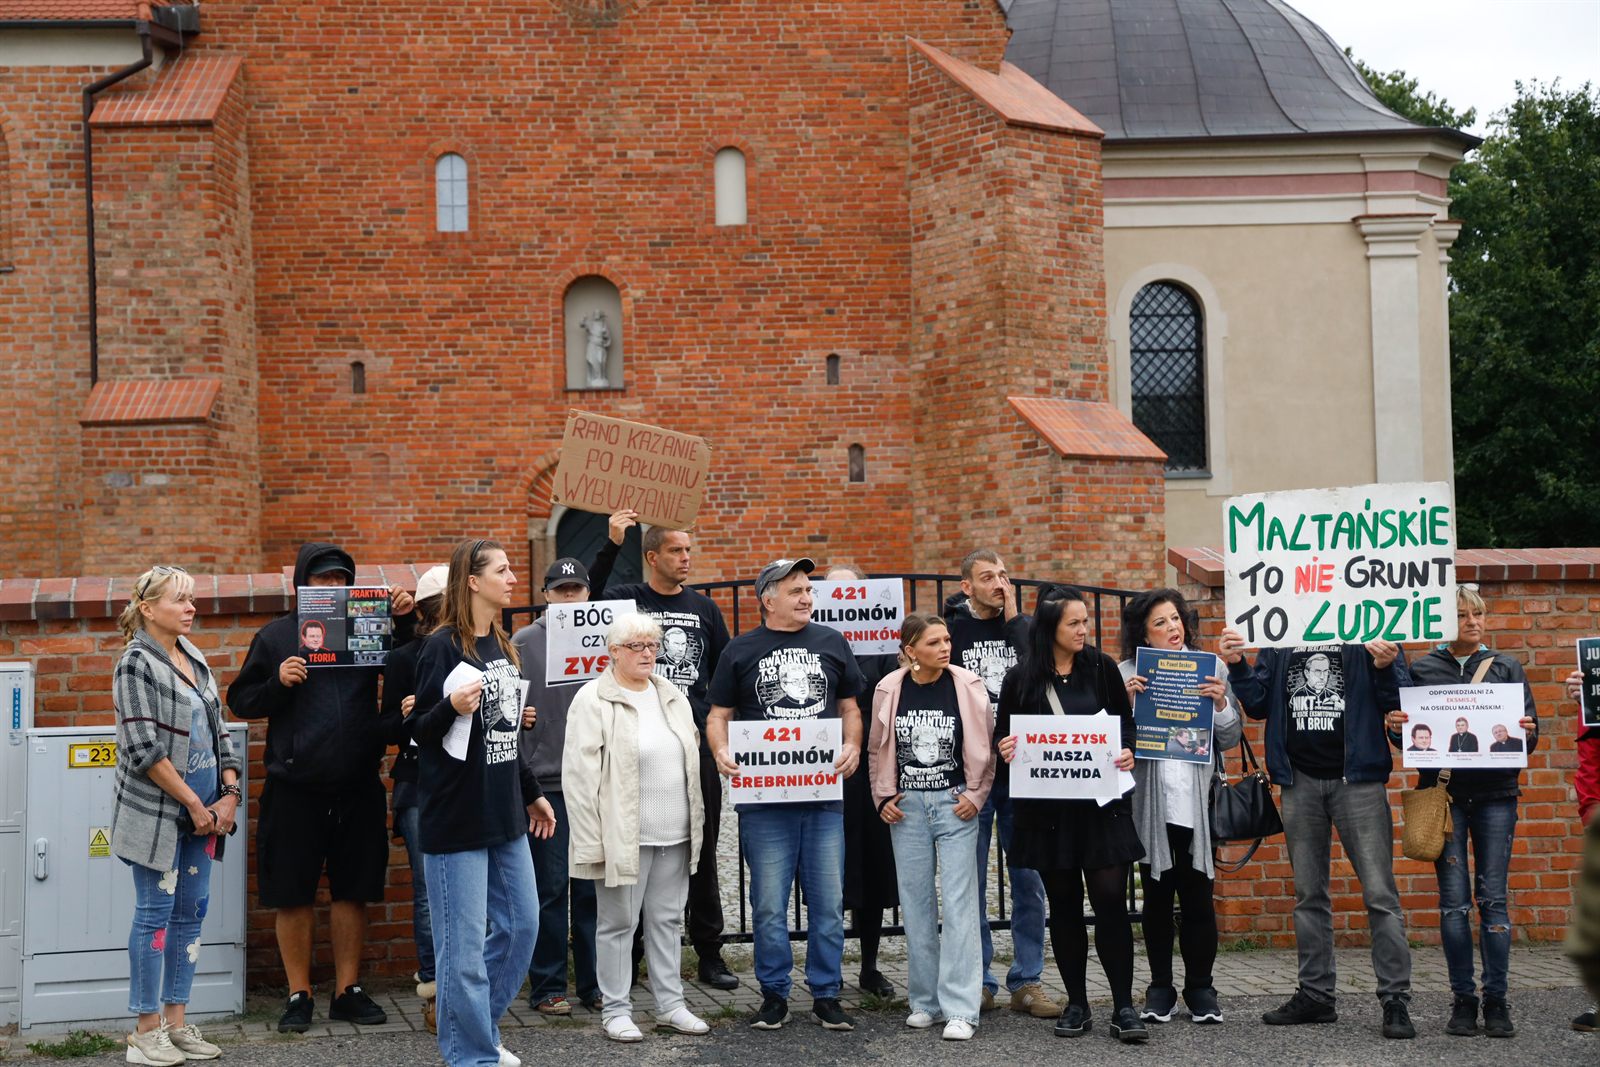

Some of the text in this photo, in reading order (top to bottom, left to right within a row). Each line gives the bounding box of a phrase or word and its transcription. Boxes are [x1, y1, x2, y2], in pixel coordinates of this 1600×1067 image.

[572, 417, 700, 461] RANO KAZANIE
[586, 449, 700, 489] PO POŁUDNIU
[564, 472, 692, 523] WYBURZANIE
[1229, 497, 1449, 553] MALTAŃSKIE
[562, 563, 575, 574] NY
[1239, 555, 1452, 596] TO NIE GRUNT
[350, 589, 388, 598] PRAKTYKA
[832, 586, 866, 600] 421
[574, 604, 614, 626] BÓG
[1235, 591, 1442, 643] TO LUDZIE
[843, 627, 900, 641] RNIKÓW
[582, 636, 608, 648] CZY
[309, 653, 336, 662] TEORIA
[963, 660, 979, 669] TO
[564, 655, 611, 675] ZYS
[759, 668, 777, 677] TO
[761, 674, 778, 682] JAKO
[1293, 696, 1316, 711] NIKT
[1296, 718, 1334, 730] NA BRUK
[763, 727, 801, 741] 421
[896, 728, 910, 737] TO
[1026, 734, 1107, 744] WASZ ZYSK
[492, 748, 517, 764] EKSMIS
[735, 746, 834, 766] MILIONÓW
[1043, 751, 1093, 762] NASZA
[1030, 768, 1101, 778] KRZYWDA
[905, 779, 949, 789] EKSMISJACH
